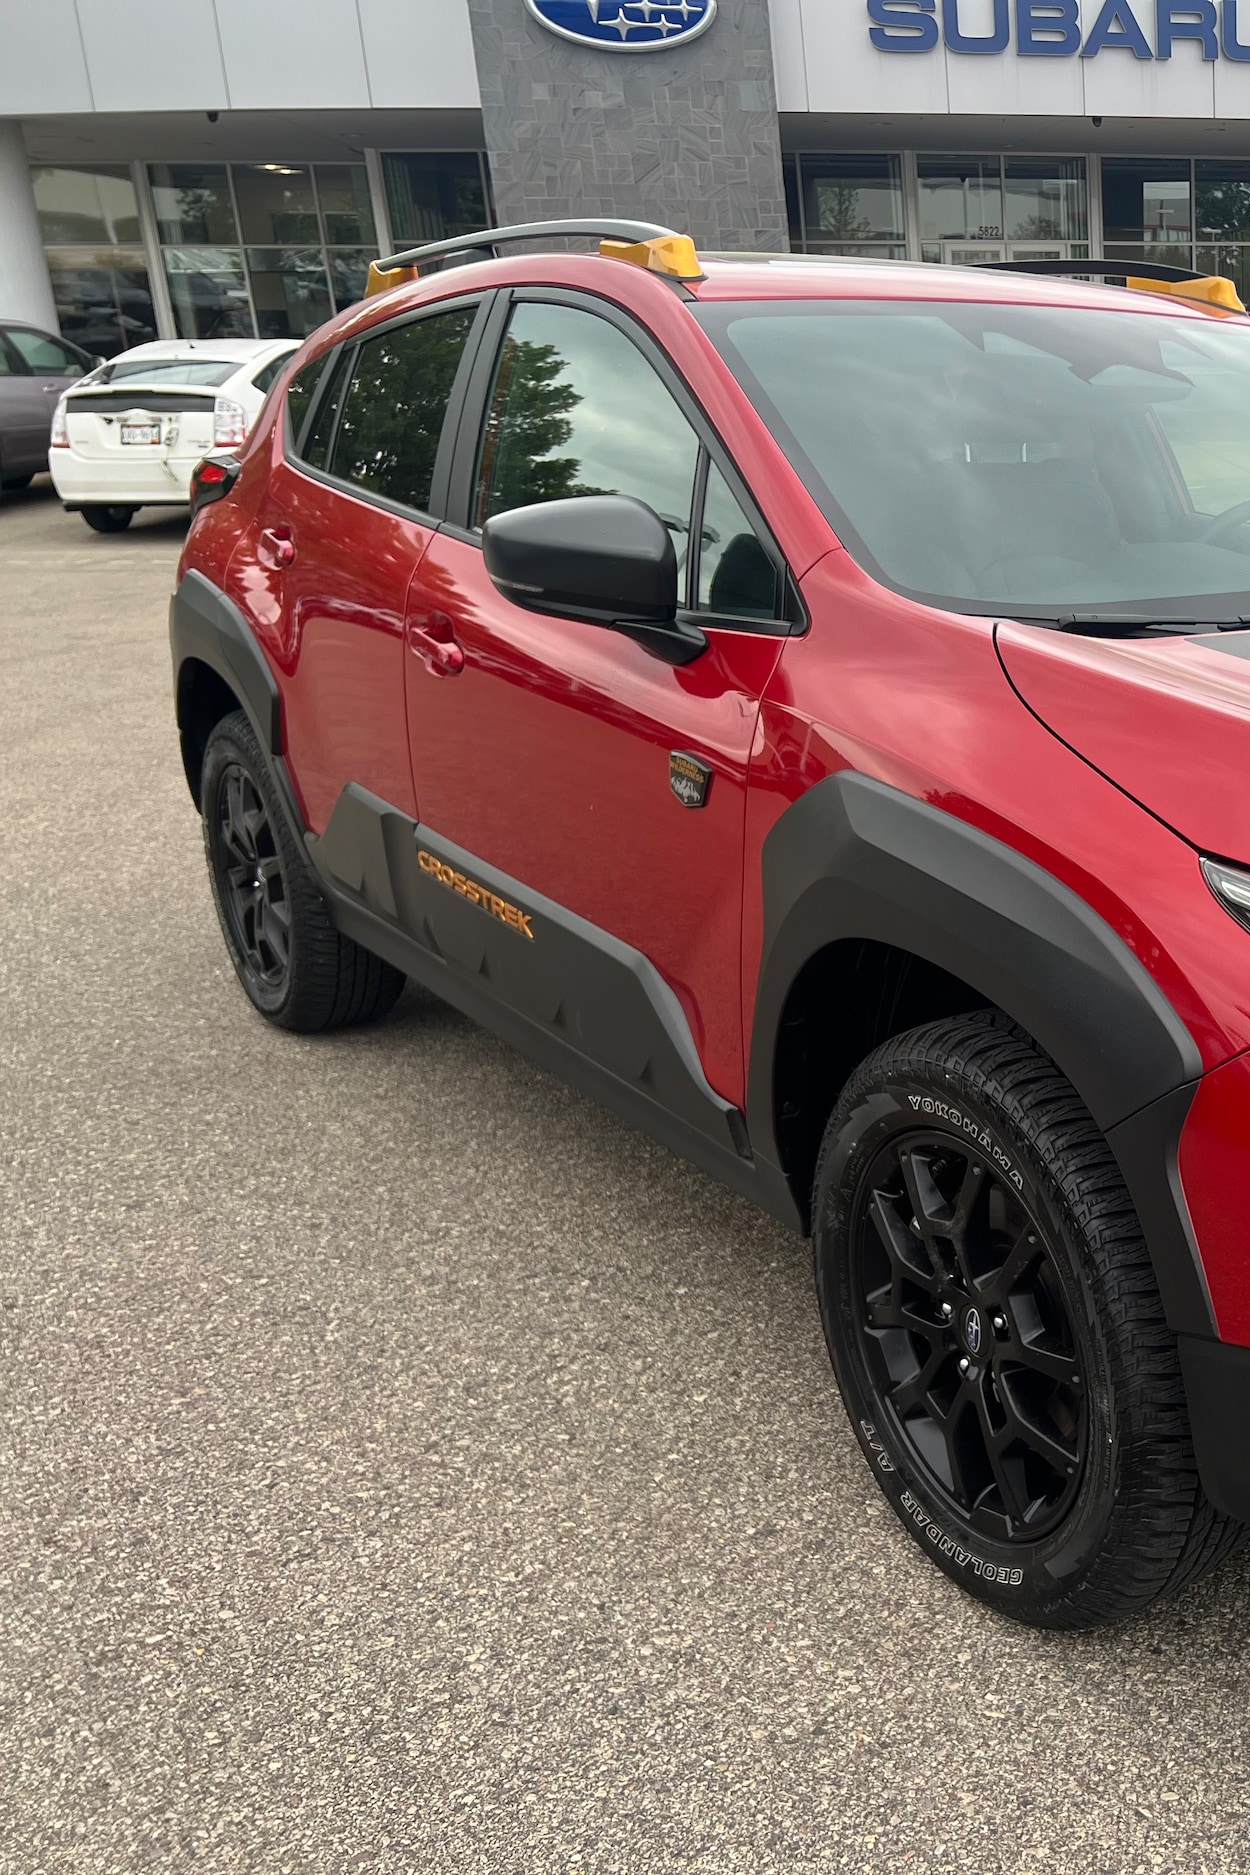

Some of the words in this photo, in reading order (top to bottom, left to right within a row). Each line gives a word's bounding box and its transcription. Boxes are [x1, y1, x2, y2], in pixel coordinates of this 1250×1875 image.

[978, 225, 1000, 237] 5822
[670, 760, 705, 784] WILDERNESS
[676, 757, 699, 773] SUBARU
[417, 850, 534, 939] CROSSTREK
[907, 1094, 1024, 1191] YOKOHAMA
[860, 1420, 896, 1473] A/T
[900, 1491, 1024, 1586] GEOLANDAR
